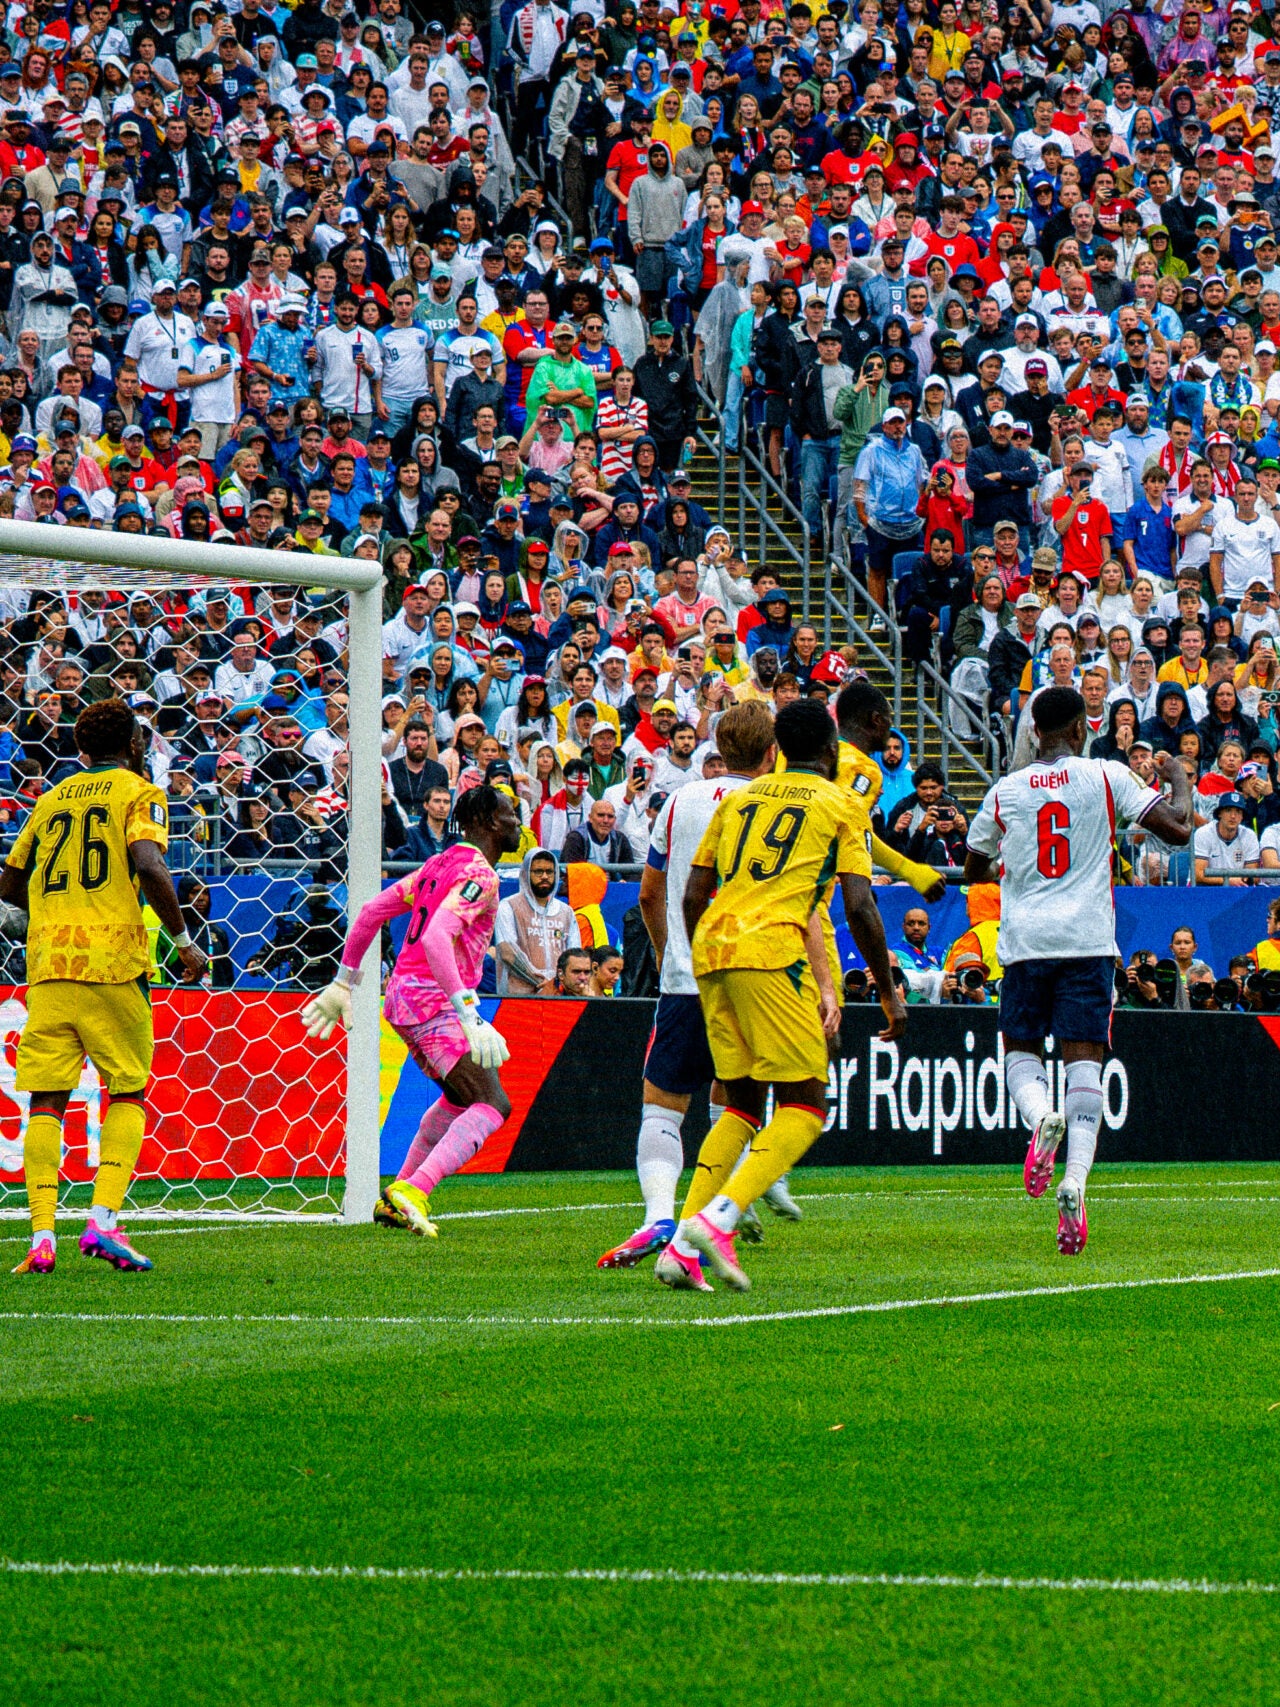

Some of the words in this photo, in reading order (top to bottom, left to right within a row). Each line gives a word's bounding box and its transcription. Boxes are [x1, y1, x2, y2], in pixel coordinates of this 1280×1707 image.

[424, 319, 443, 330] RED
[447, 318, 463, 330] SO
[387, 347, 400, 362] 19
[452, 352, 465, 366] 20
[1140, 520, 1149, 536] 7
[1081, 533, 1089, 548] 7
[1029, 769, 1070, 790] GUÉHI
[57, 780, 113, 801] SENAYA
[713, 787, 728, 801] K
[747, 783, 817, 802] WILLIAMS
[723, 799, 812, 885] 19
[1036, 800, 1071, 879] 6
[42, 803, 112, 899] 26
[1077, 1114, 1097, 1124] ENG
